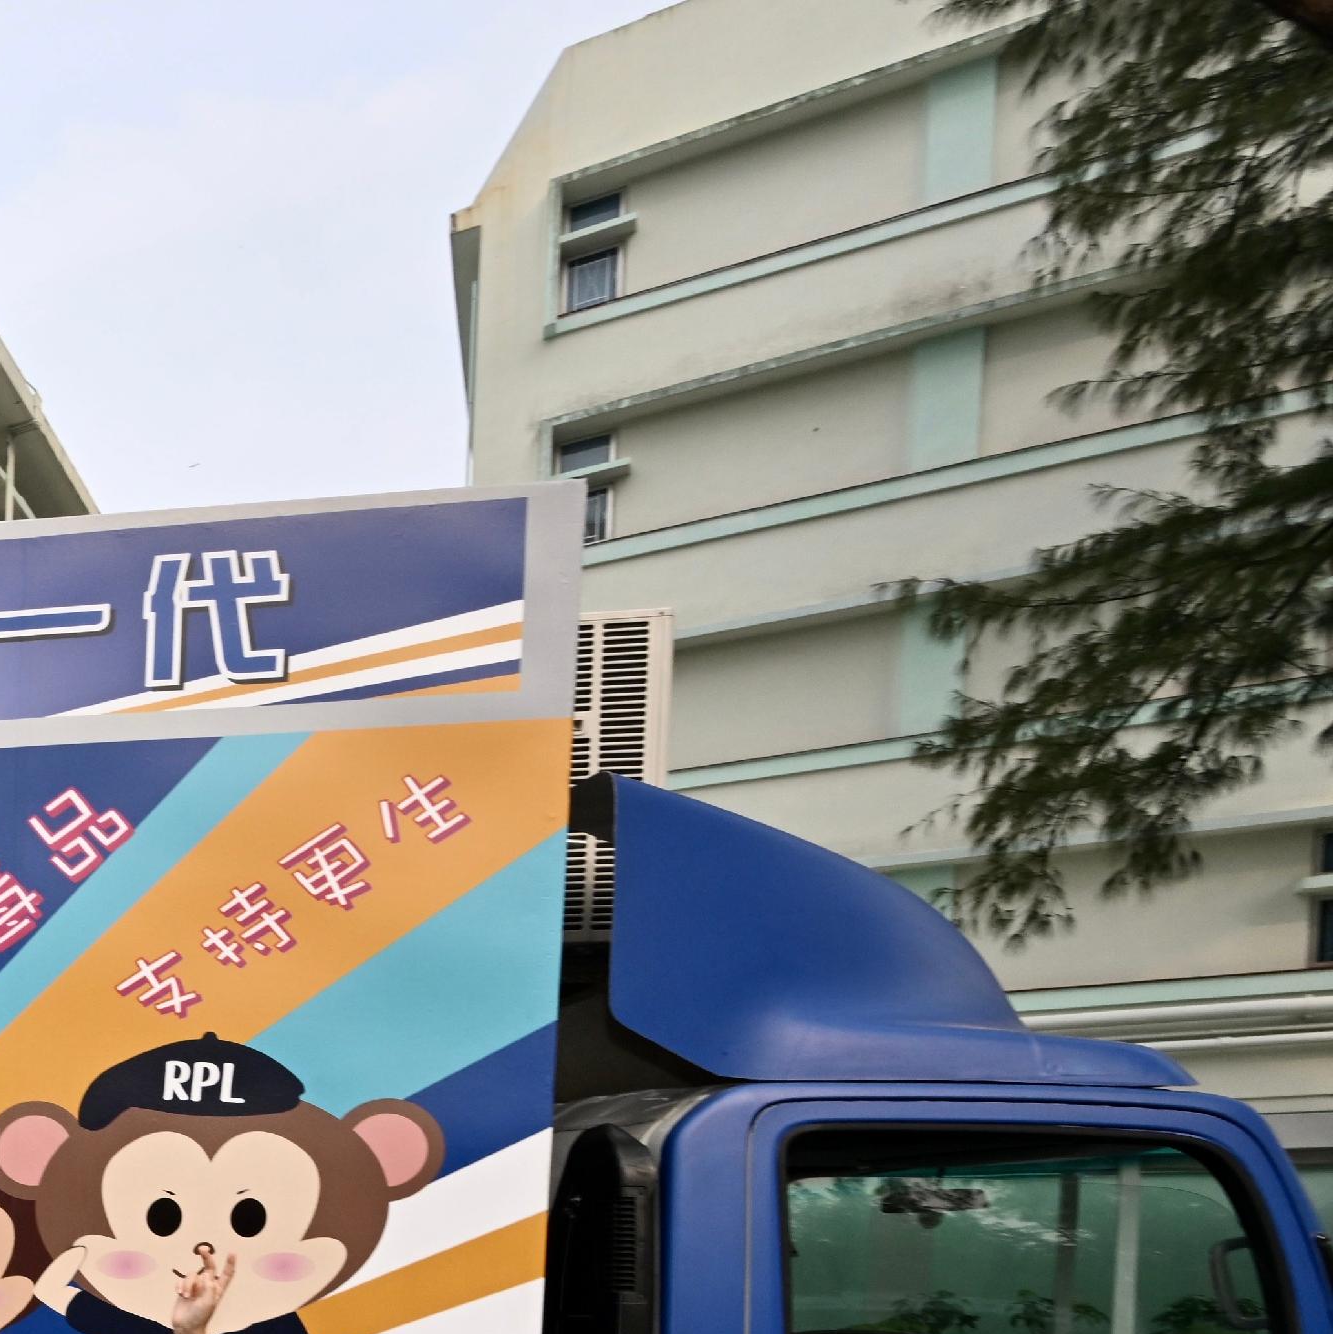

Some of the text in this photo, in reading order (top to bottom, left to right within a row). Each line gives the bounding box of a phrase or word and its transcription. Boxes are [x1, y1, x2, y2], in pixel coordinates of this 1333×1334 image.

[115, 773, 472, 1020] 支持更生
[163, 1059, 246, 1105] RPL
